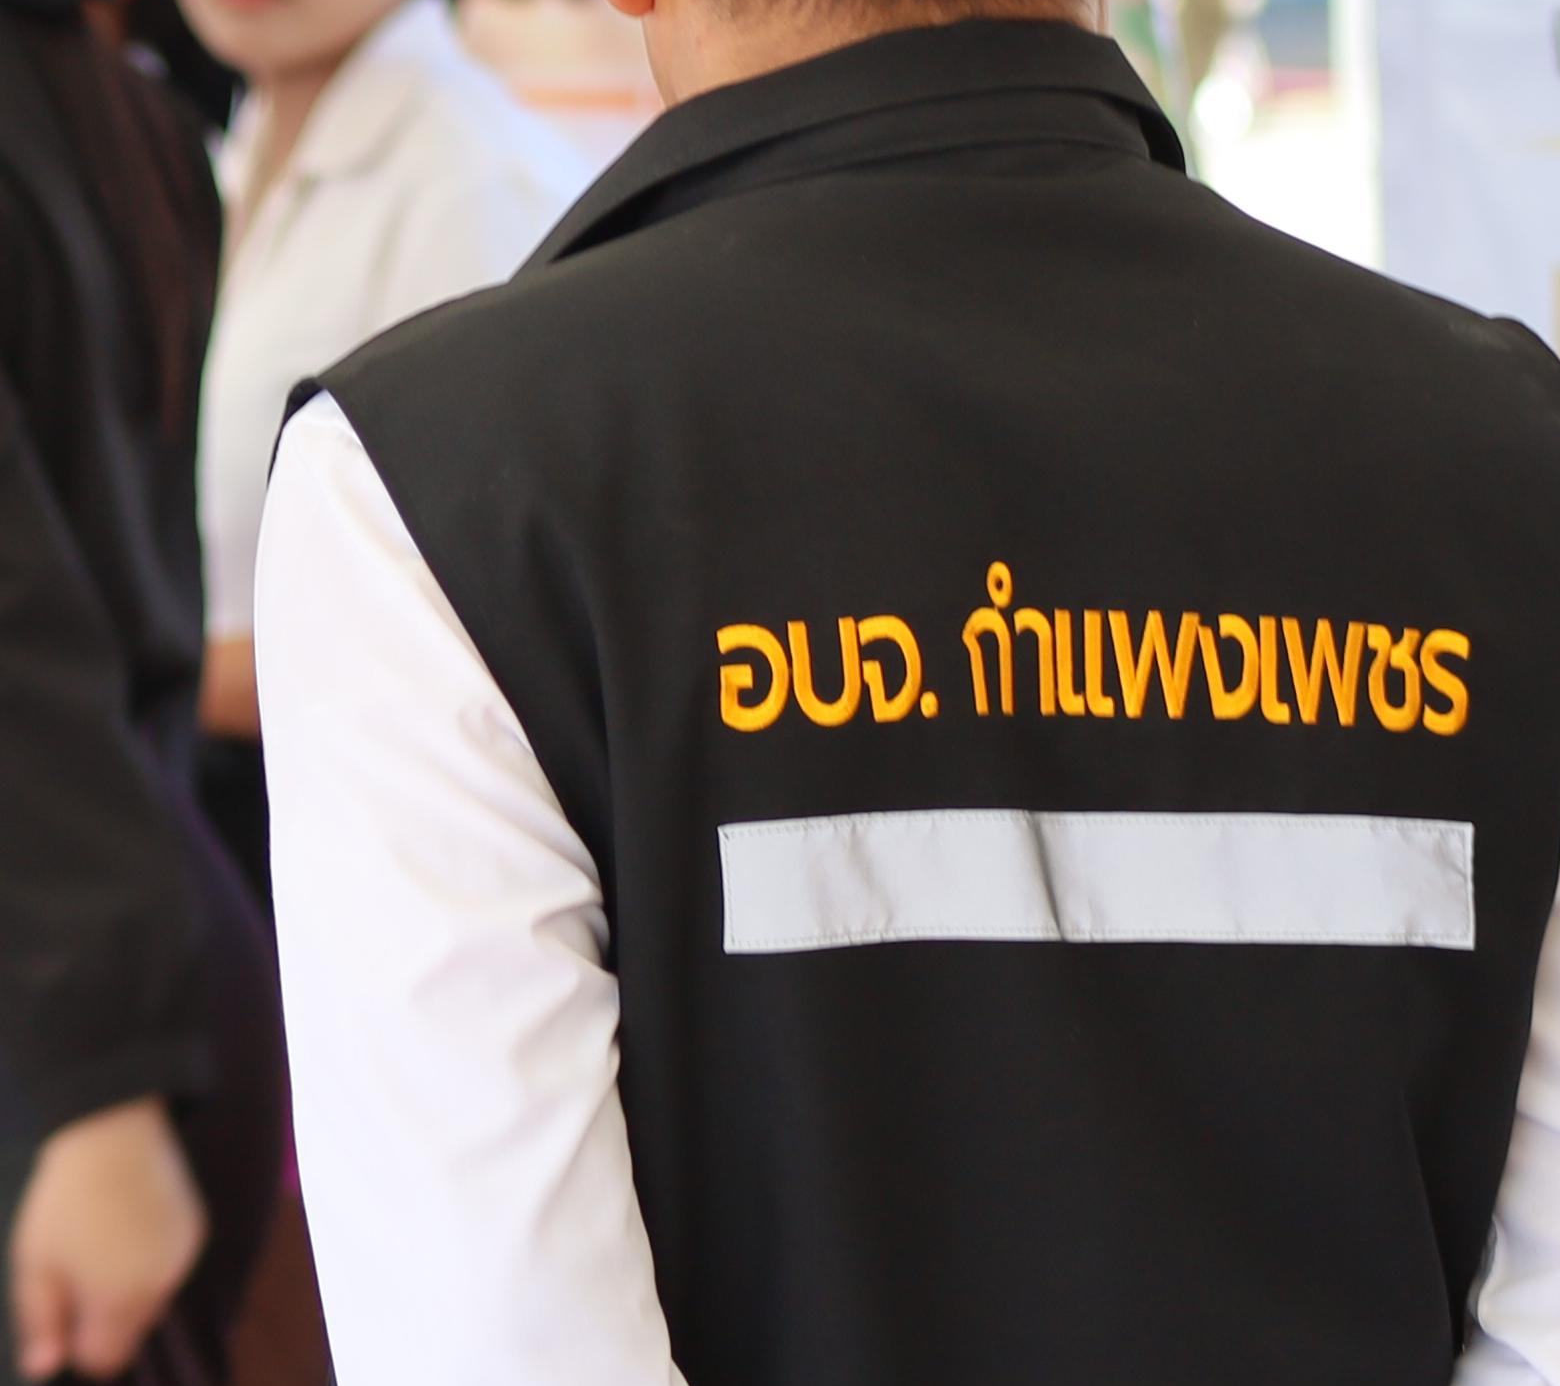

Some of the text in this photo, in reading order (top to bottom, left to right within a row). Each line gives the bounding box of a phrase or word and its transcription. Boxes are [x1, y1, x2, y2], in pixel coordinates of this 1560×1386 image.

[717, 561, 1471, 736] อบจ. กำแพงเพชร
